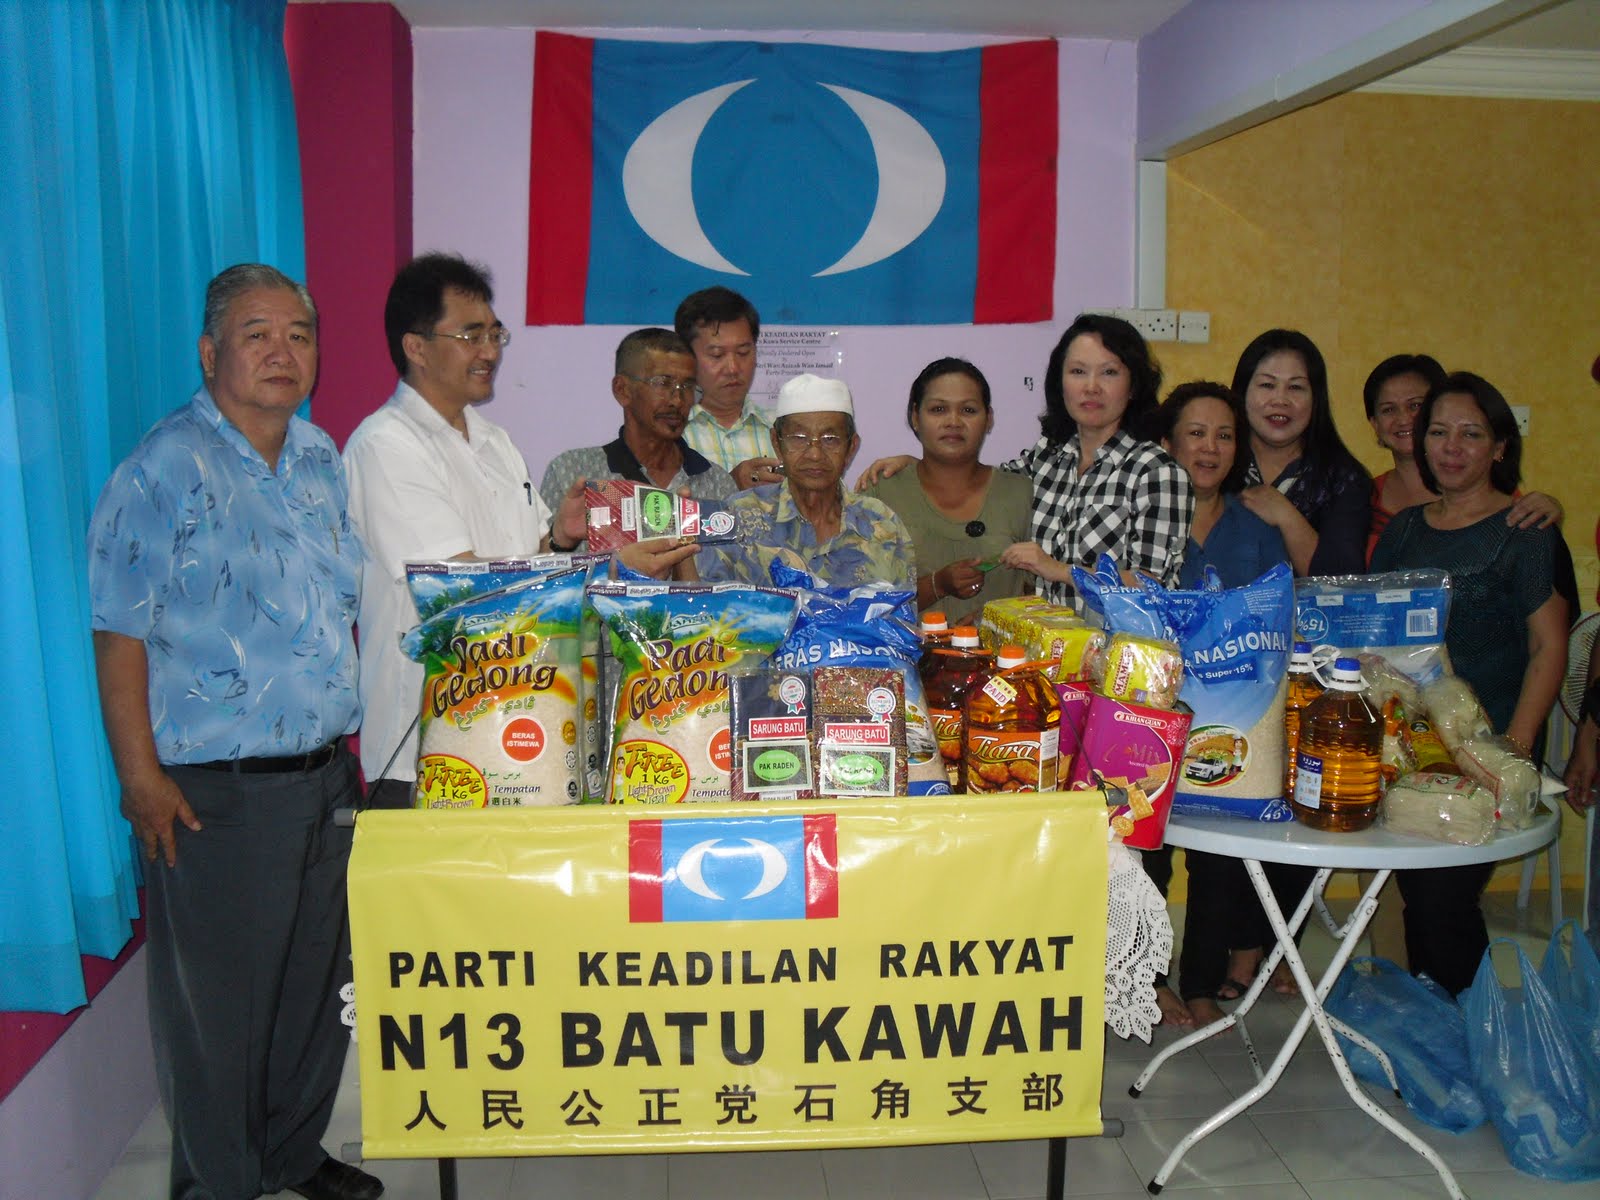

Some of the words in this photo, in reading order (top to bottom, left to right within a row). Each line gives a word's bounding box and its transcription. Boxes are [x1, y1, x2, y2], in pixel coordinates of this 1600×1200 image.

[645, 636, 725, 672] Padi
[776, 645, 822, 668] ERAS
[1194, 631, 1287, 665] NASIONAL
[1205, 669, 1232, 679] Super
[1234, 663, 1254, 674] 15%
[431, 664, 558, 718] Gedong
[628, 669, 730, 720] Gedon
[985, 683, 1007, 703] PAID
[753, 724, 782, 735] SARUNG
[784, 723, 803, 733] BATU
[828, 729, 862, 739] SARUNG
[865, 729, 886, 739] BATU
[931, 714, 961, 736] Tia
[506, 740, 540, 748] ISTIMEWA
[972, 735, 1042, 761] Tiara
[624, 743, 685, 779] FREE
[424, 757, 483, 794] FREE
[642, 774, 648, 783] 1
[654, 775, 669, 784] KG
[441, 788, 447, 797] 1
[452, 789, 468, 799] KG
[494, 785, 541, 794] Tempatan
[692, 788, 731, 798] Tempata
[389, 950, 535, 988] PARTI
[579, 947, 836, 986] KEADILAN
[880, 935, 1074, 978] RAKYAT
[379, 1012, 525, 1071] N13
[561, 1009, 765, 1068] BATU
[804, 996, 1083, 1064] KAWAH
[404, 1071, 1064, 1131] 人民公正党石角支部
